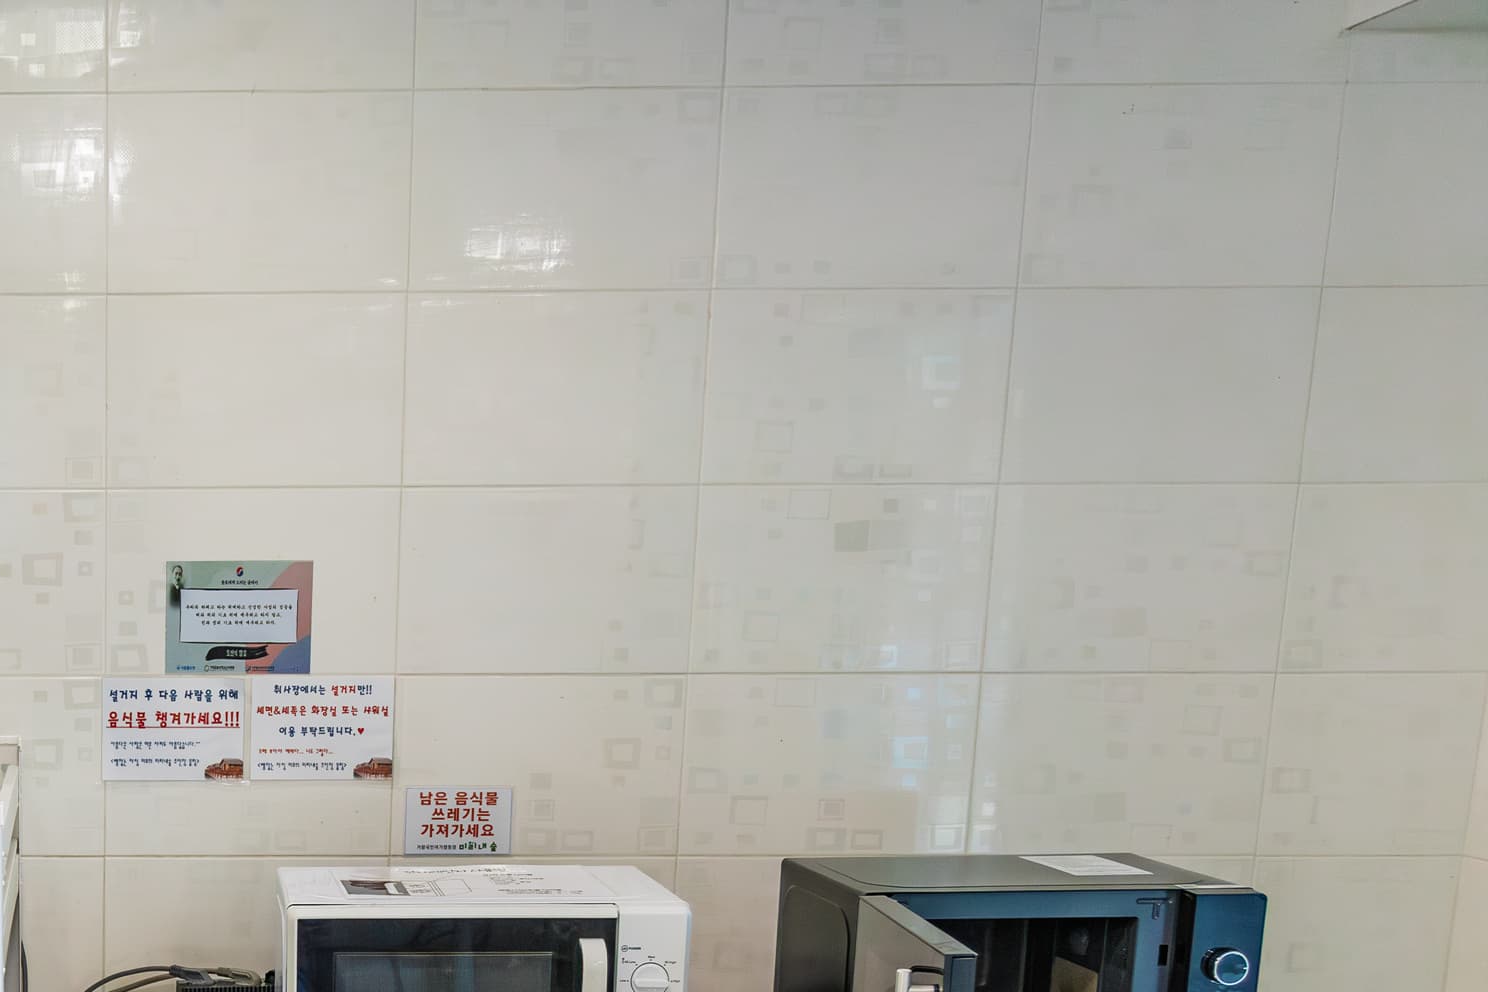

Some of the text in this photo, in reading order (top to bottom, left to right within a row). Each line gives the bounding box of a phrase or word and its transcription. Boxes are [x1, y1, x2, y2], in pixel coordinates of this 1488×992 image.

[110, 688, 239, 702] 설거지 후 다음 사람을 위해
[311, 706, 337, 717] 화장실
[342, 706, 358, 716] 또는
[363, 706, 389, 717] 샤워실
[108, 710, 240, 728] 음식물 챙겨가세요!!!
[278, 726, 296, 737] 이용
[420, 792, 499, 806] 남은 음식물
[432, 808, 490, 822] 쓰레기는
[420, 824, 494, 838] 가져가세요
